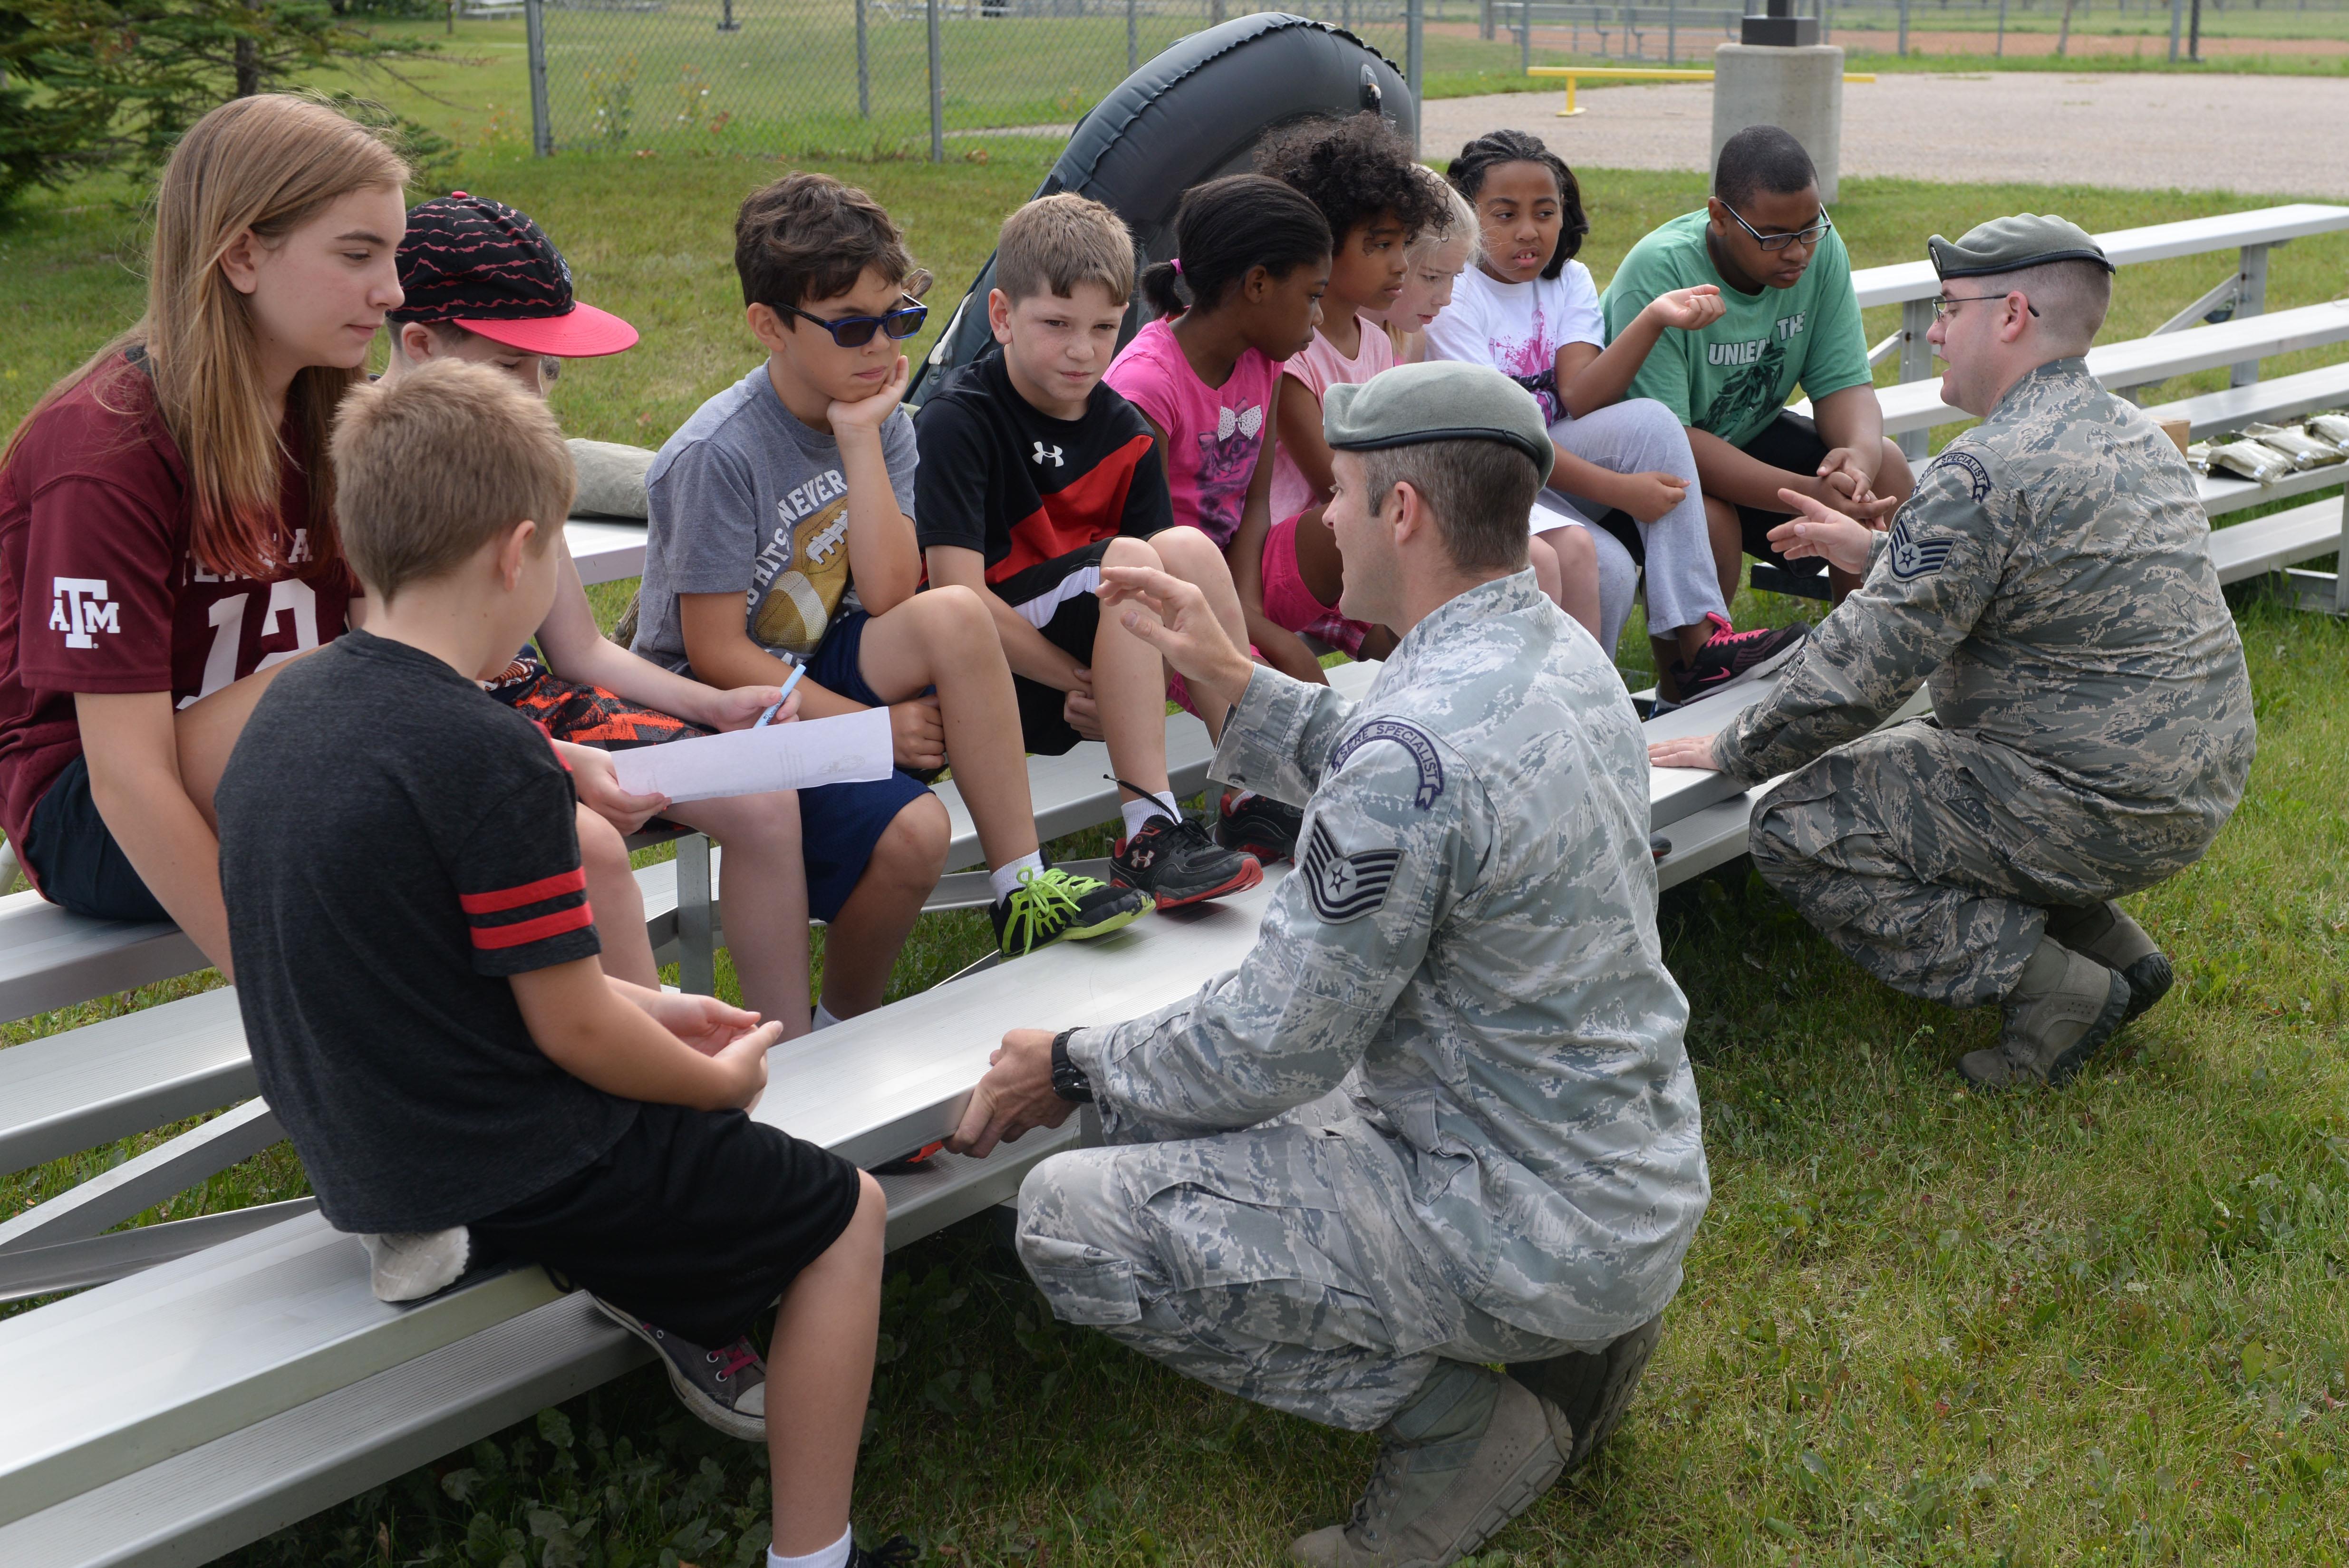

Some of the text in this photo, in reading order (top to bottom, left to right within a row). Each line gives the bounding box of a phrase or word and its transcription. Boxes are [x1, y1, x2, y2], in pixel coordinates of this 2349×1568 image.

[1941, 455, 1986, 483] SPECIALIST
[777, 469, 848, 529] NEVER
[1340, 725, 1439, 779] SERE SPECIALIST
